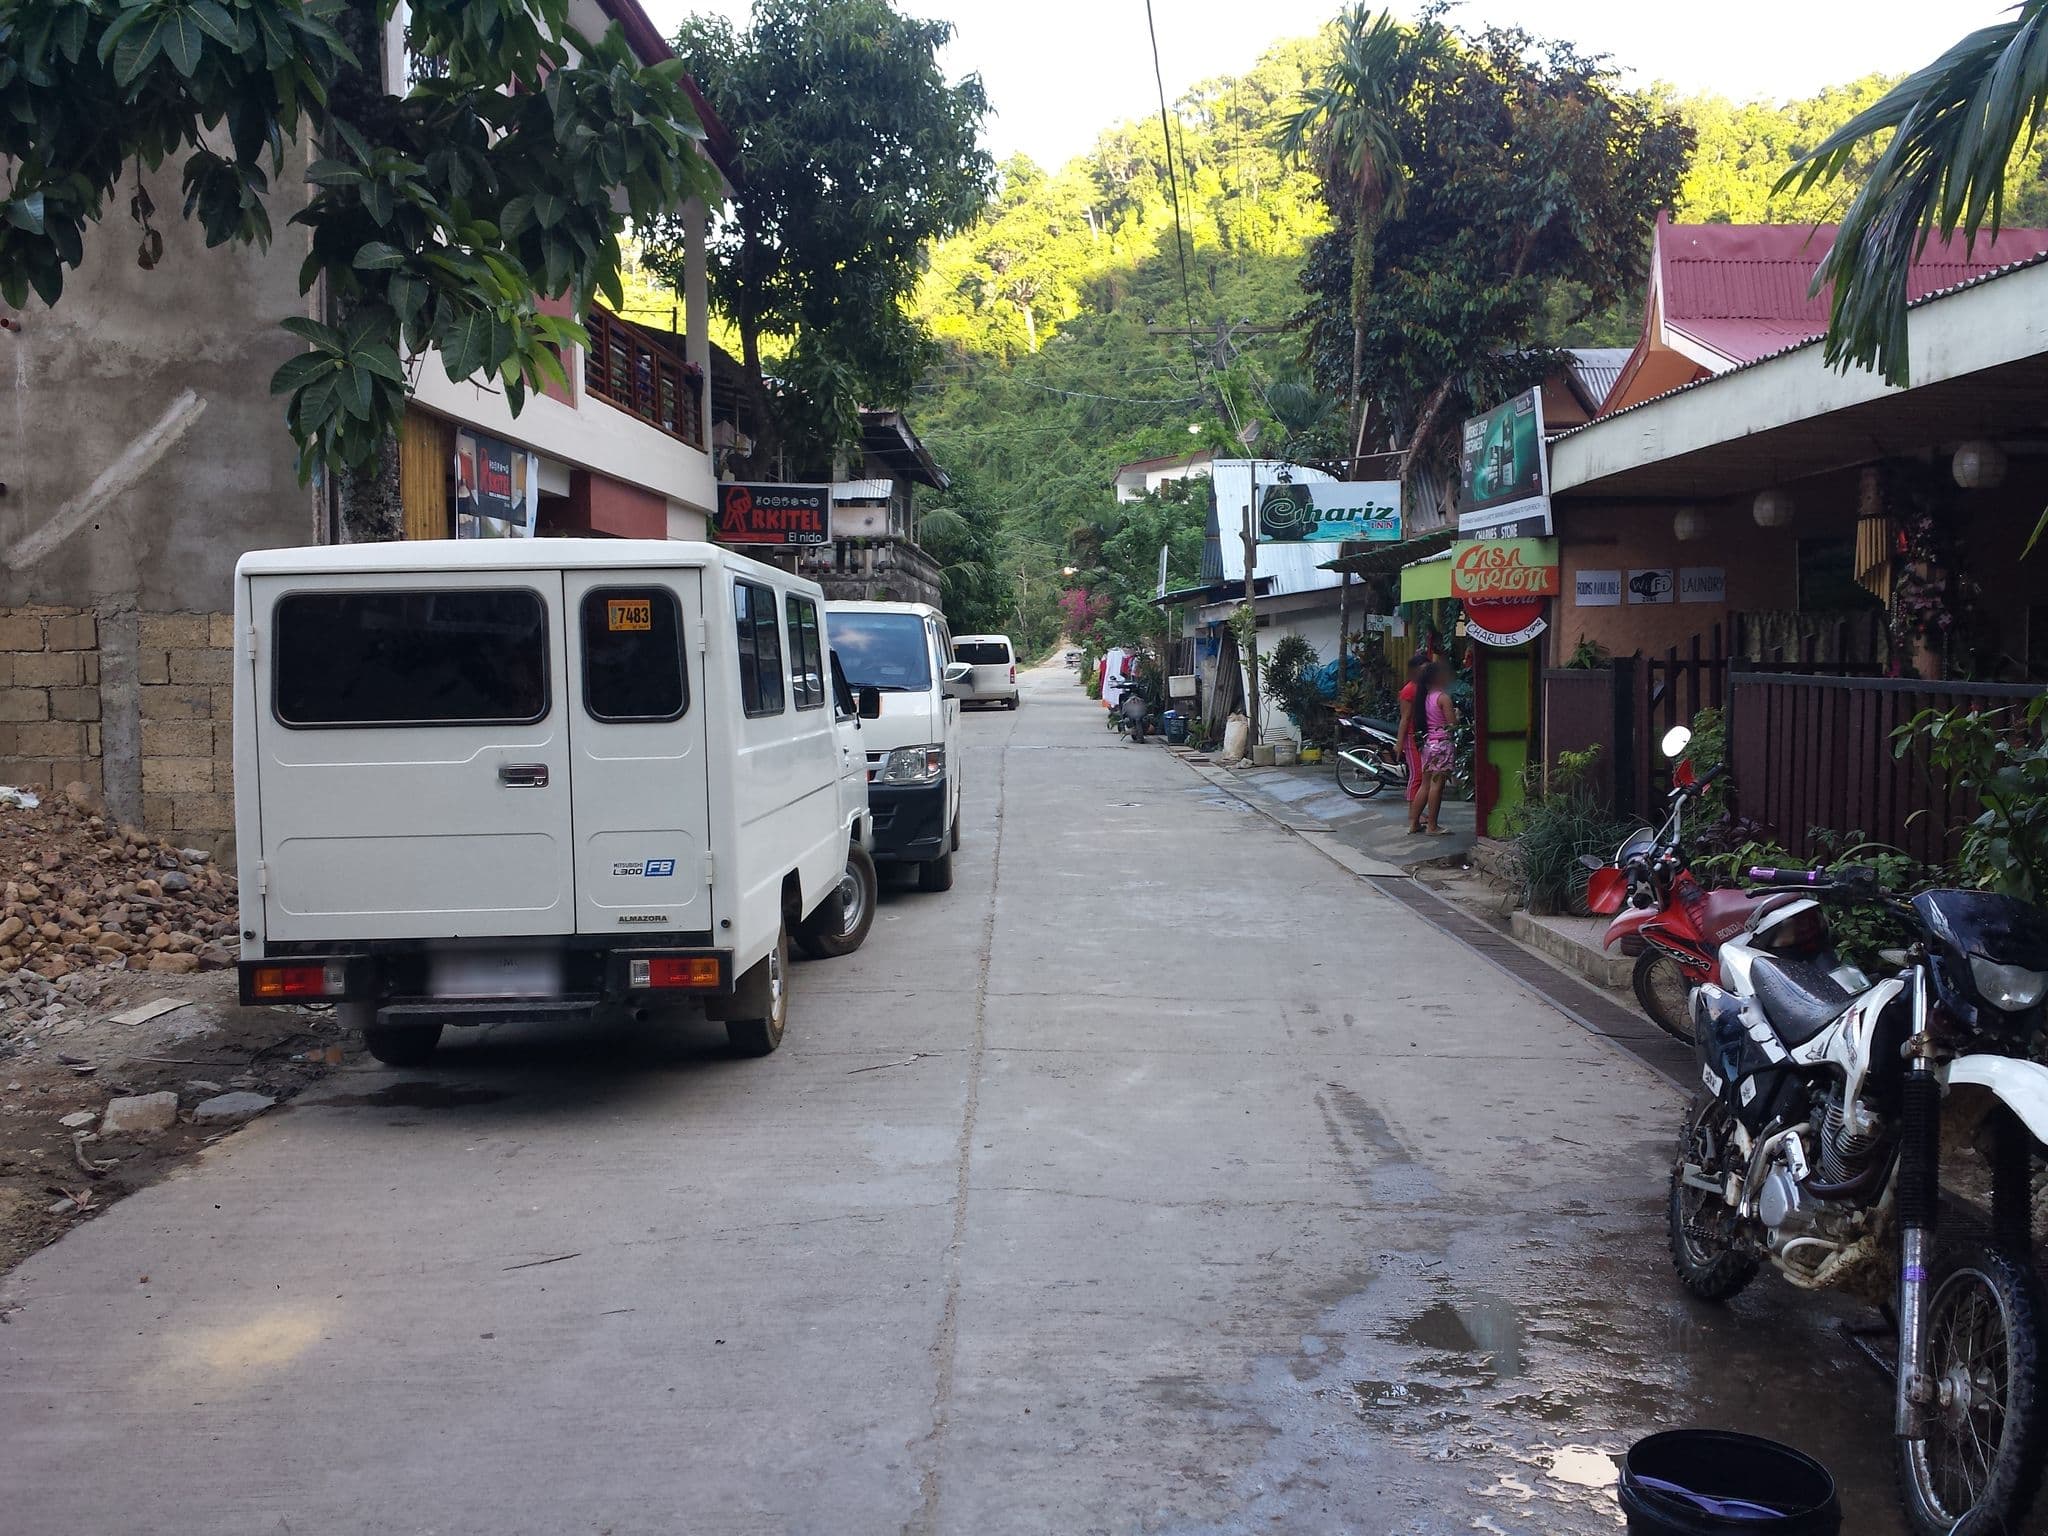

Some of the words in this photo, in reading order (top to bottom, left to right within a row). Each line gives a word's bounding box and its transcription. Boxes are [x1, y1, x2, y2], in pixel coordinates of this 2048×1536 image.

[1262, 498, 1394, 528] Chariz
[799, 532, 822, 543] nido
[1501, 523, 1518, 539] STORE
[1577, 582, 1593, 595] ROOMS
[1682, 575, 1724, 593] LAUNDRY
[617, 607, 650, 624] 7483
[1466, 623, 1519, 645] CHARLLES
[647, 861, 673, 872] FB
